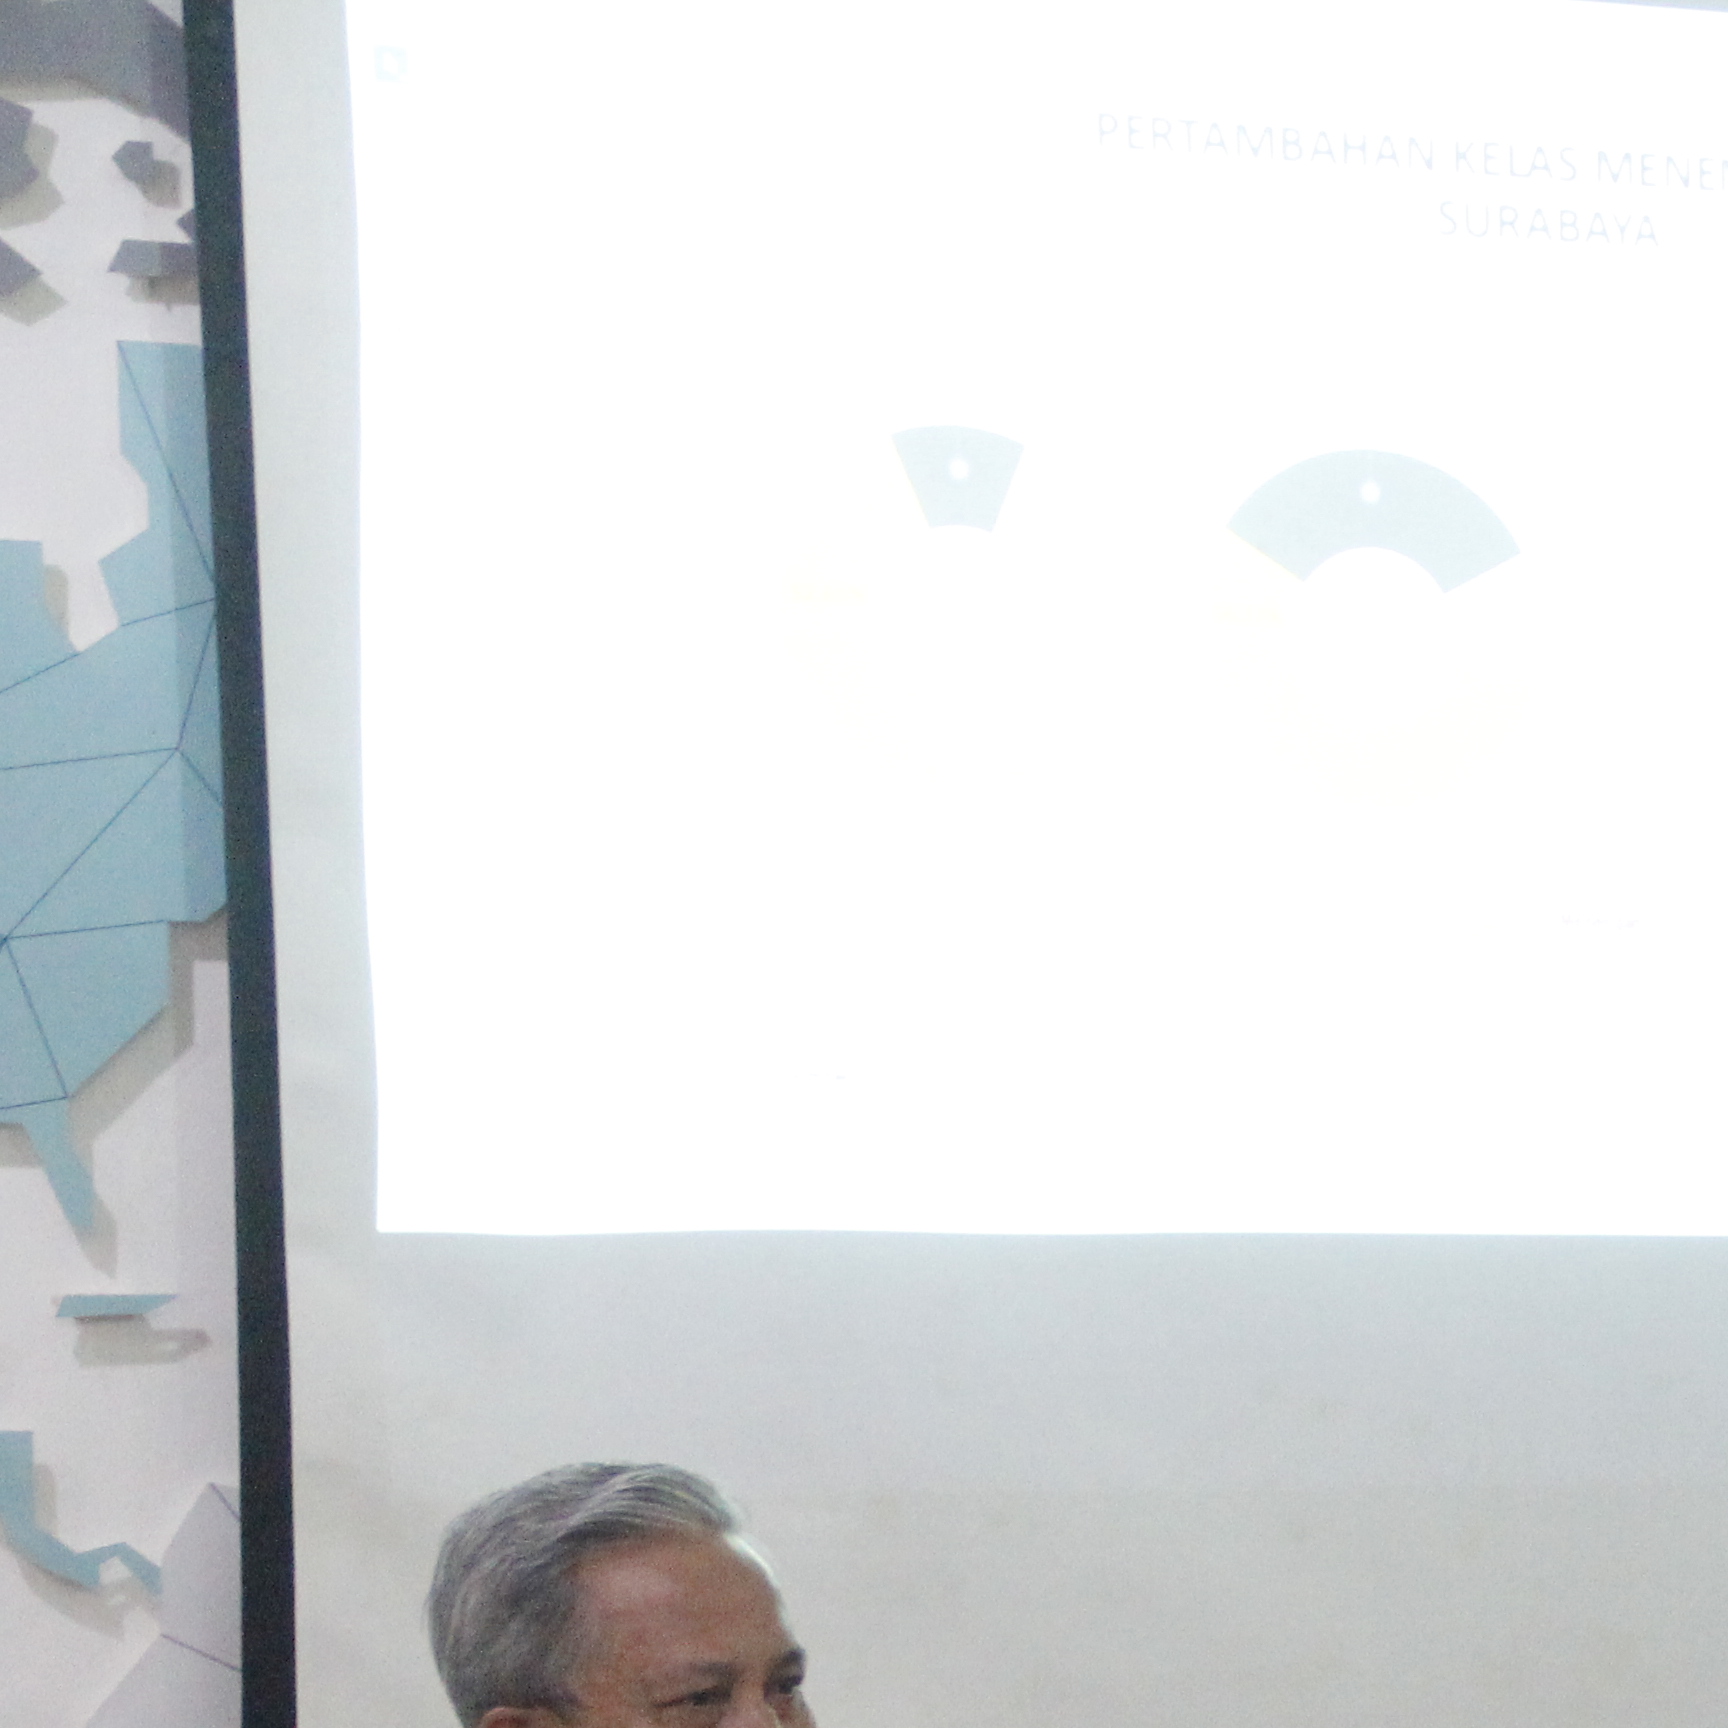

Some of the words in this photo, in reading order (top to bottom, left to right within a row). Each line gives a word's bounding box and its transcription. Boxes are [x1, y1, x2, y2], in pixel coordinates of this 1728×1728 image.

[1097, 113, 1434, 171] PERTAMBAHAN
[1454, 140, 1577, 181] KELAS
[1440, 201, 1659, 246] SURABAYA
